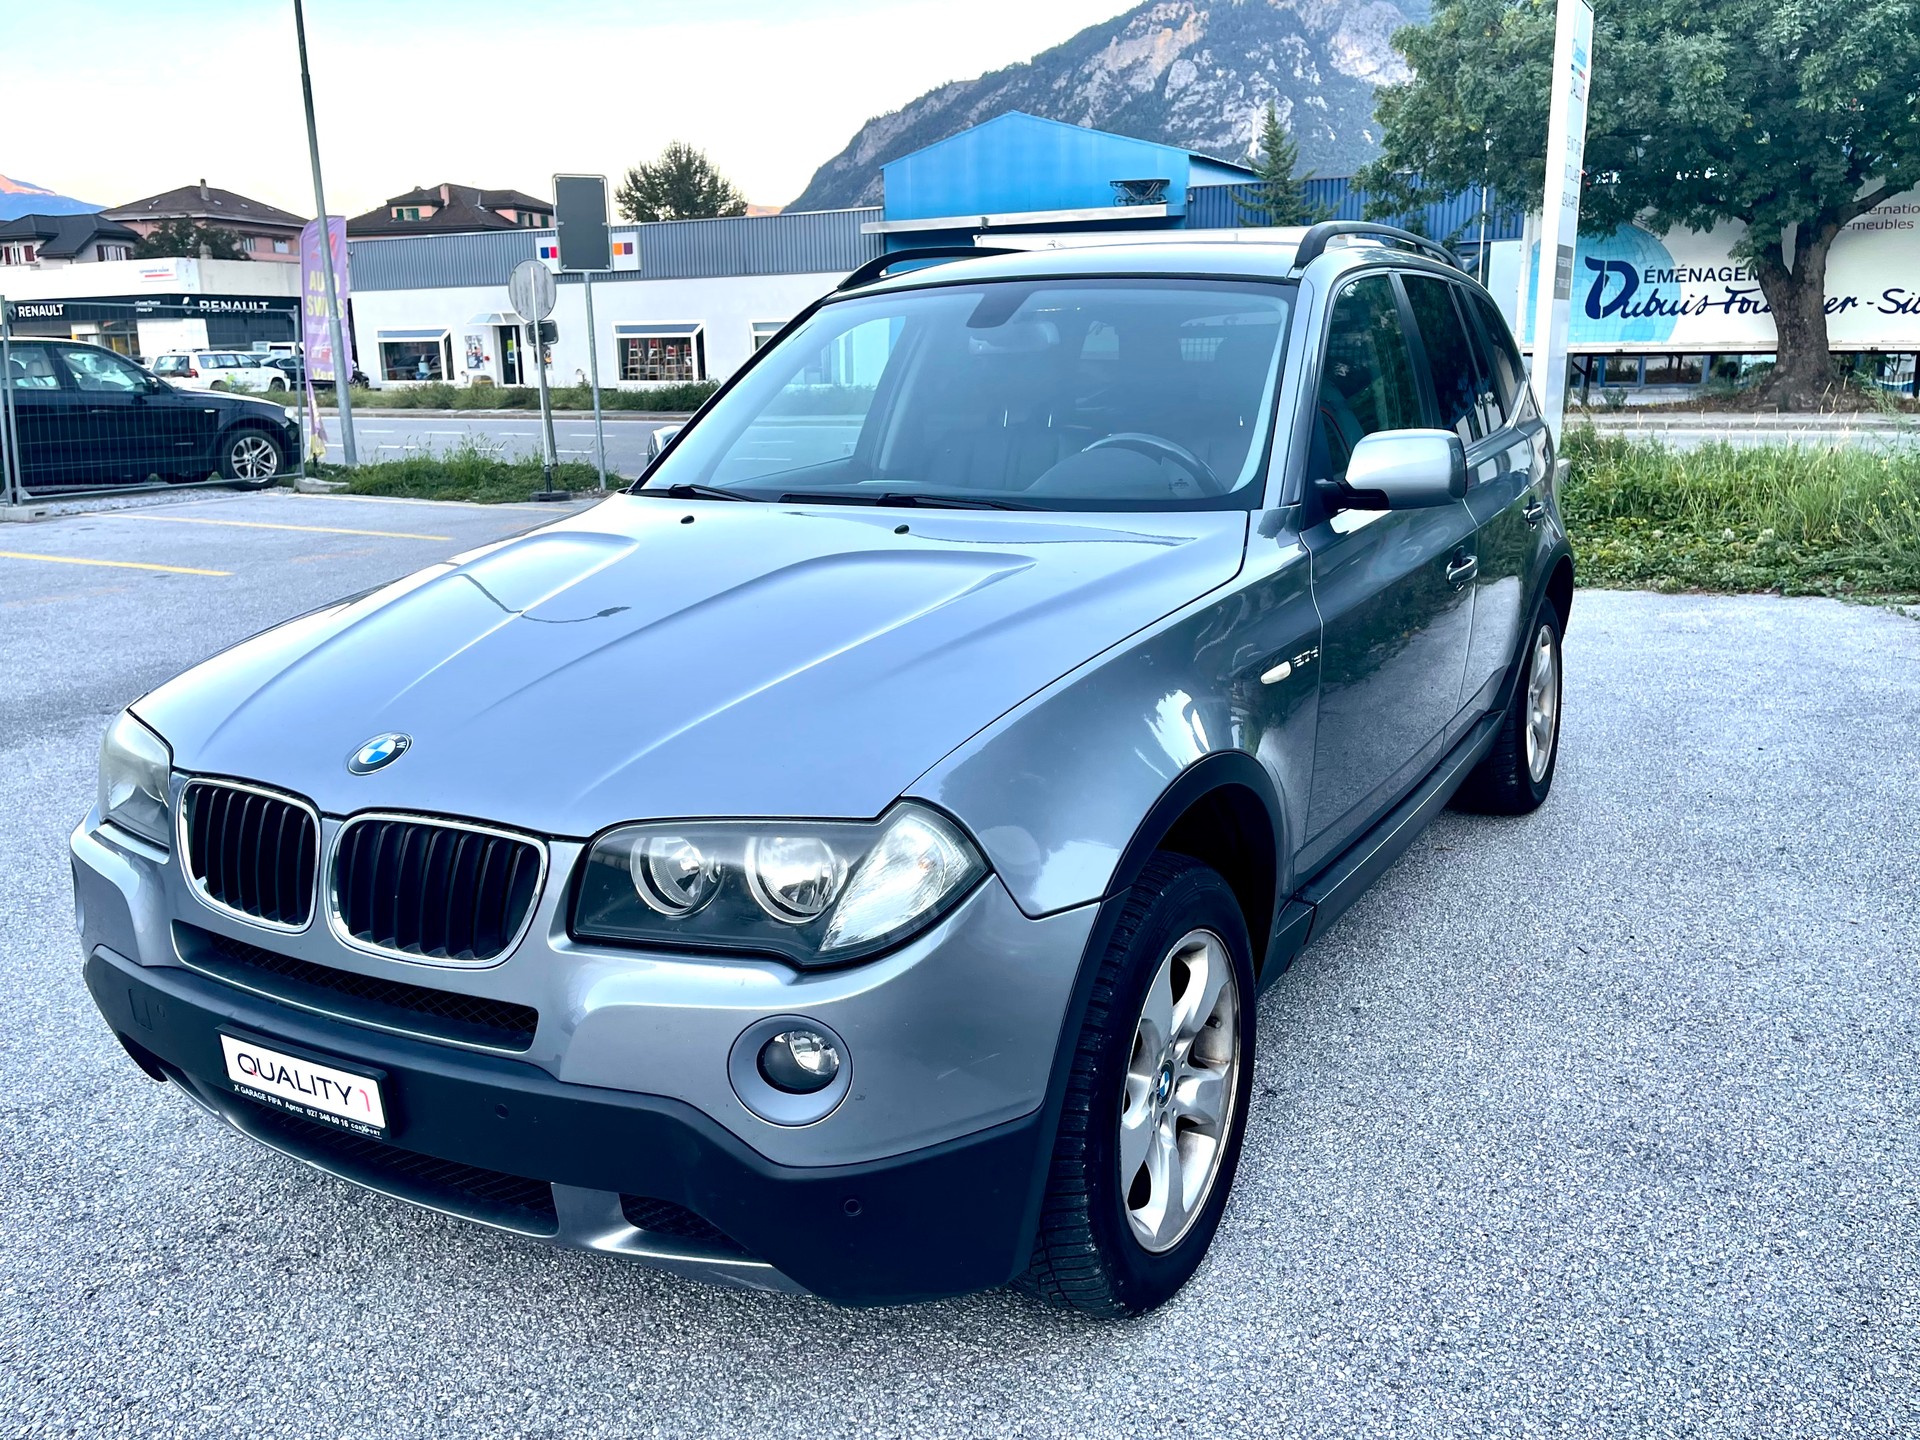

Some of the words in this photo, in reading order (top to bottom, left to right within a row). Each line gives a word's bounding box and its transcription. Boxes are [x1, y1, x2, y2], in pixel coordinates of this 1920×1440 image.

[1864, 202, 1920, 215] ernatio
[309, 270, 340, 294] AUO
[18, 304, 64, 318] RENAULT
[199, 300, 269, 314] RENAULT
[307, 295, 344, 319] SWIS
[238, 1053, 352, 1105] QUALITY
[240, 1086, 267, 1102] GARAGE
[267, 1095, 283, 1107] FIFA
[285, 1101, 304, 1114] Aproz
[306, 1108, 318, 1118] 027
